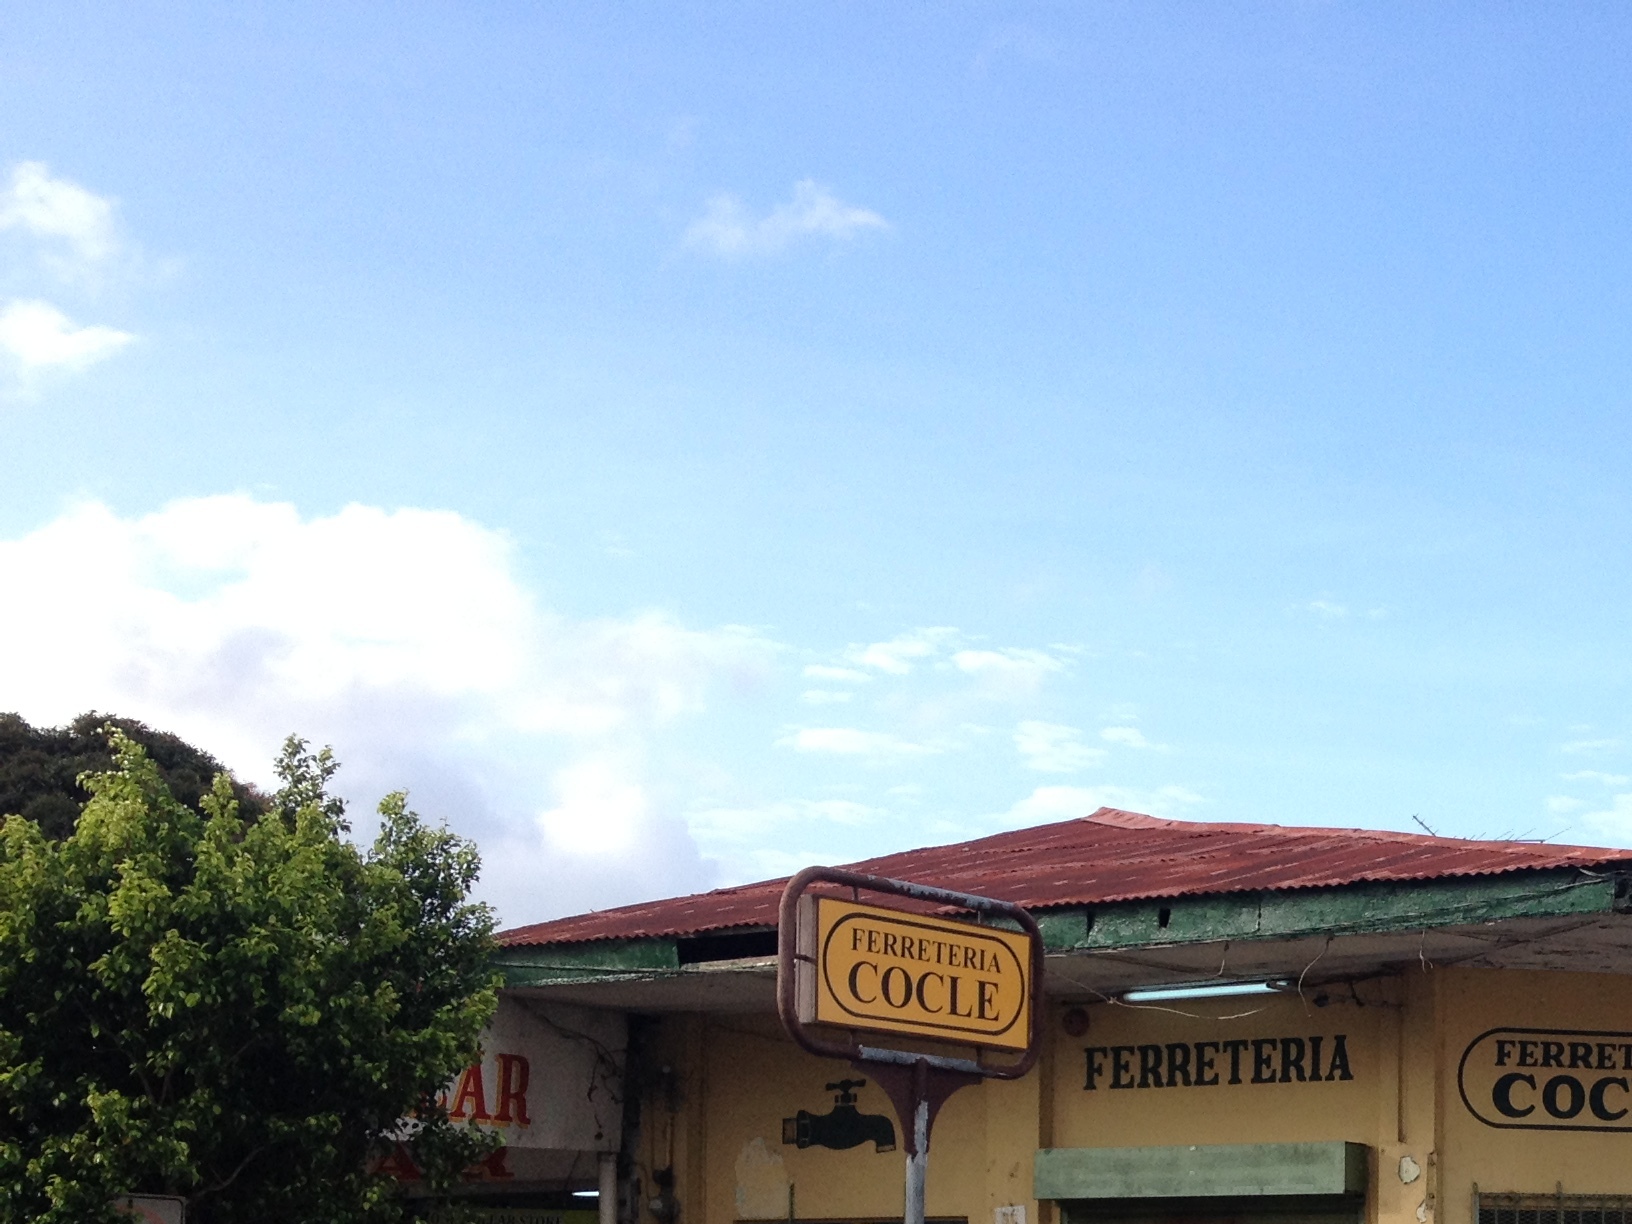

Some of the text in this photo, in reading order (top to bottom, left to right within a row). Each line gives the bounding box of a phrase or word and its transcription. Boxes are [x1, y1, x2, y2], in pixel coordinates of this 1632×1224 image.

[851, 927, 1002, 975] FERRETERIA
[847, 961, 1000, 1022] COCLE
[1083, 1035, 1354, 1091] FERRETERIA
